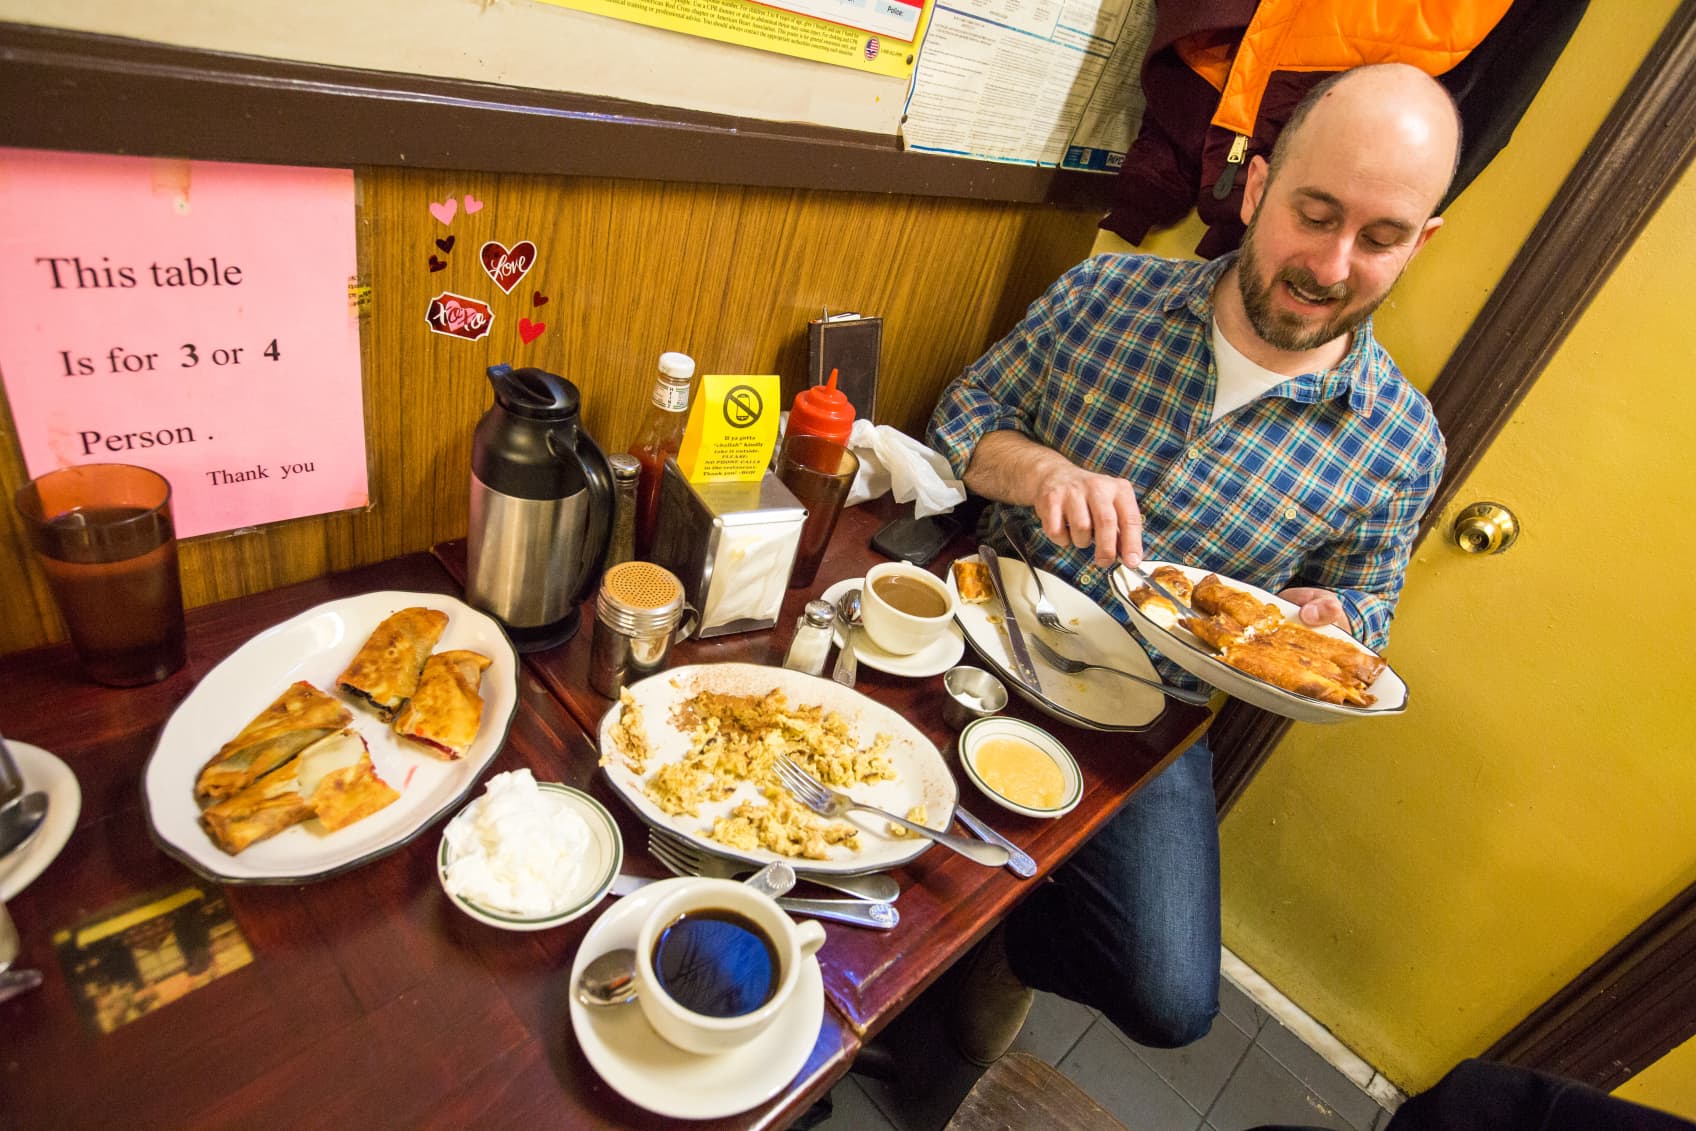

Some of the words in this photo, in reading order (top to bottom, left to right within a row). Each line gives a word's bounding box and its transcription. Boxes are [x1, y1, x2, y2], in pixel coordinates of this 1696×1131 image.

[35, 257, 138, 289] This
[151, 257, 244, 288] table
[60, 350, 95, 377] Is
[107, 346, 160, 373] for
[180, 343, 200, 368] 3
[212, 345, 244, 366] or
[263, 339, 281, 362] 4
[78, 426, 197, 456] Person
[206, 464, 269, 486] Thank
[280, 461, 315, 480] you
